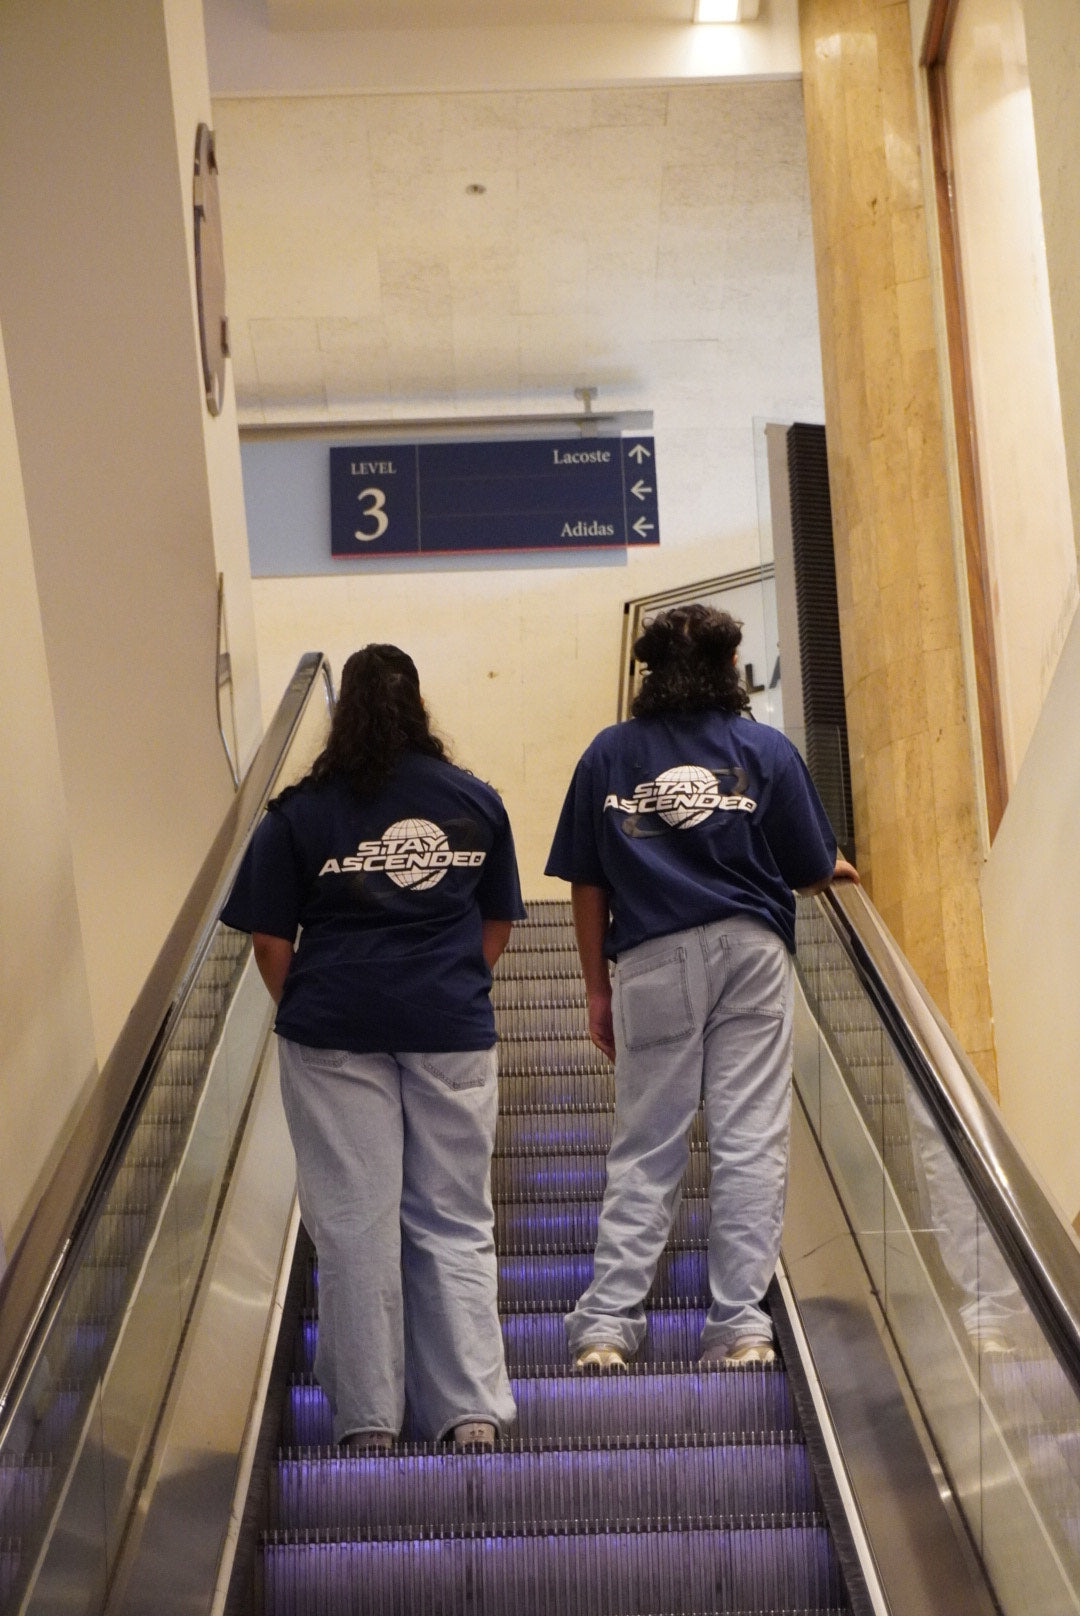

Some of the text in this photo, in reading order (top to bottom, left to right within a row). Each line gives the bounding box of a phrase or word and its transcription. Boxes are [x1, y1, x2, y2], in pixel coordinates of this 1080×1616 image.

[553, 449, 611, 465] Lacoste
[350, 461, 397, 475] LEVEL
[354, 487, 389, 542] 3
[560, 520, 615, 538] Adidas
[633, 780, 720, 800] STAY
[603, 794, 758, 814] ASCENDED
[356, 836, 448, 857] STAY
[318, 851, 487, 877] ASCENDED
